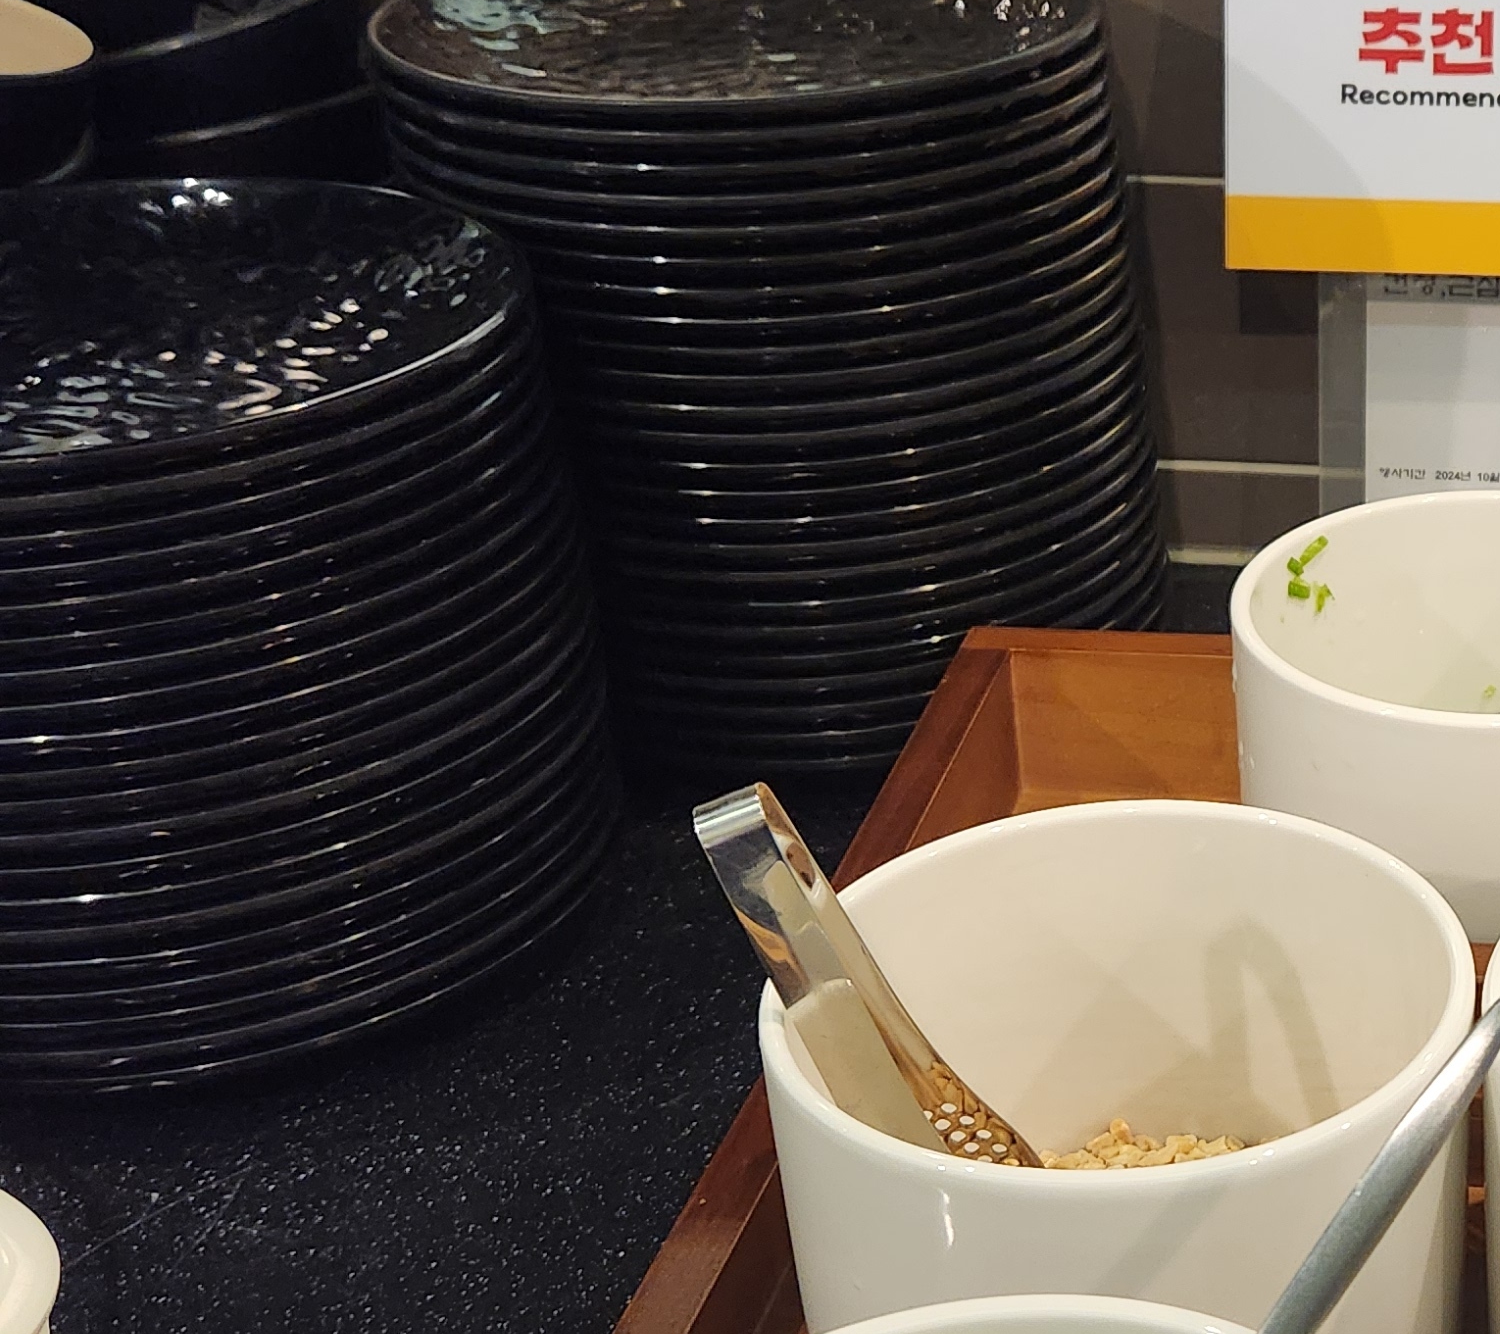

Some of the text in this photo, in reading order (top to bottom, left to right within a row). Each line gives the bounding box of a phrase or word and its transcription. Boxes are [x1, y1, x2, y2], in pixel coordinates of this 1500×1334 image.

[1358, 7, 1495, 76] 추천
[1434, 469, 1472, 482] 2024년
[1477, 471, 1500, 483] 10월
